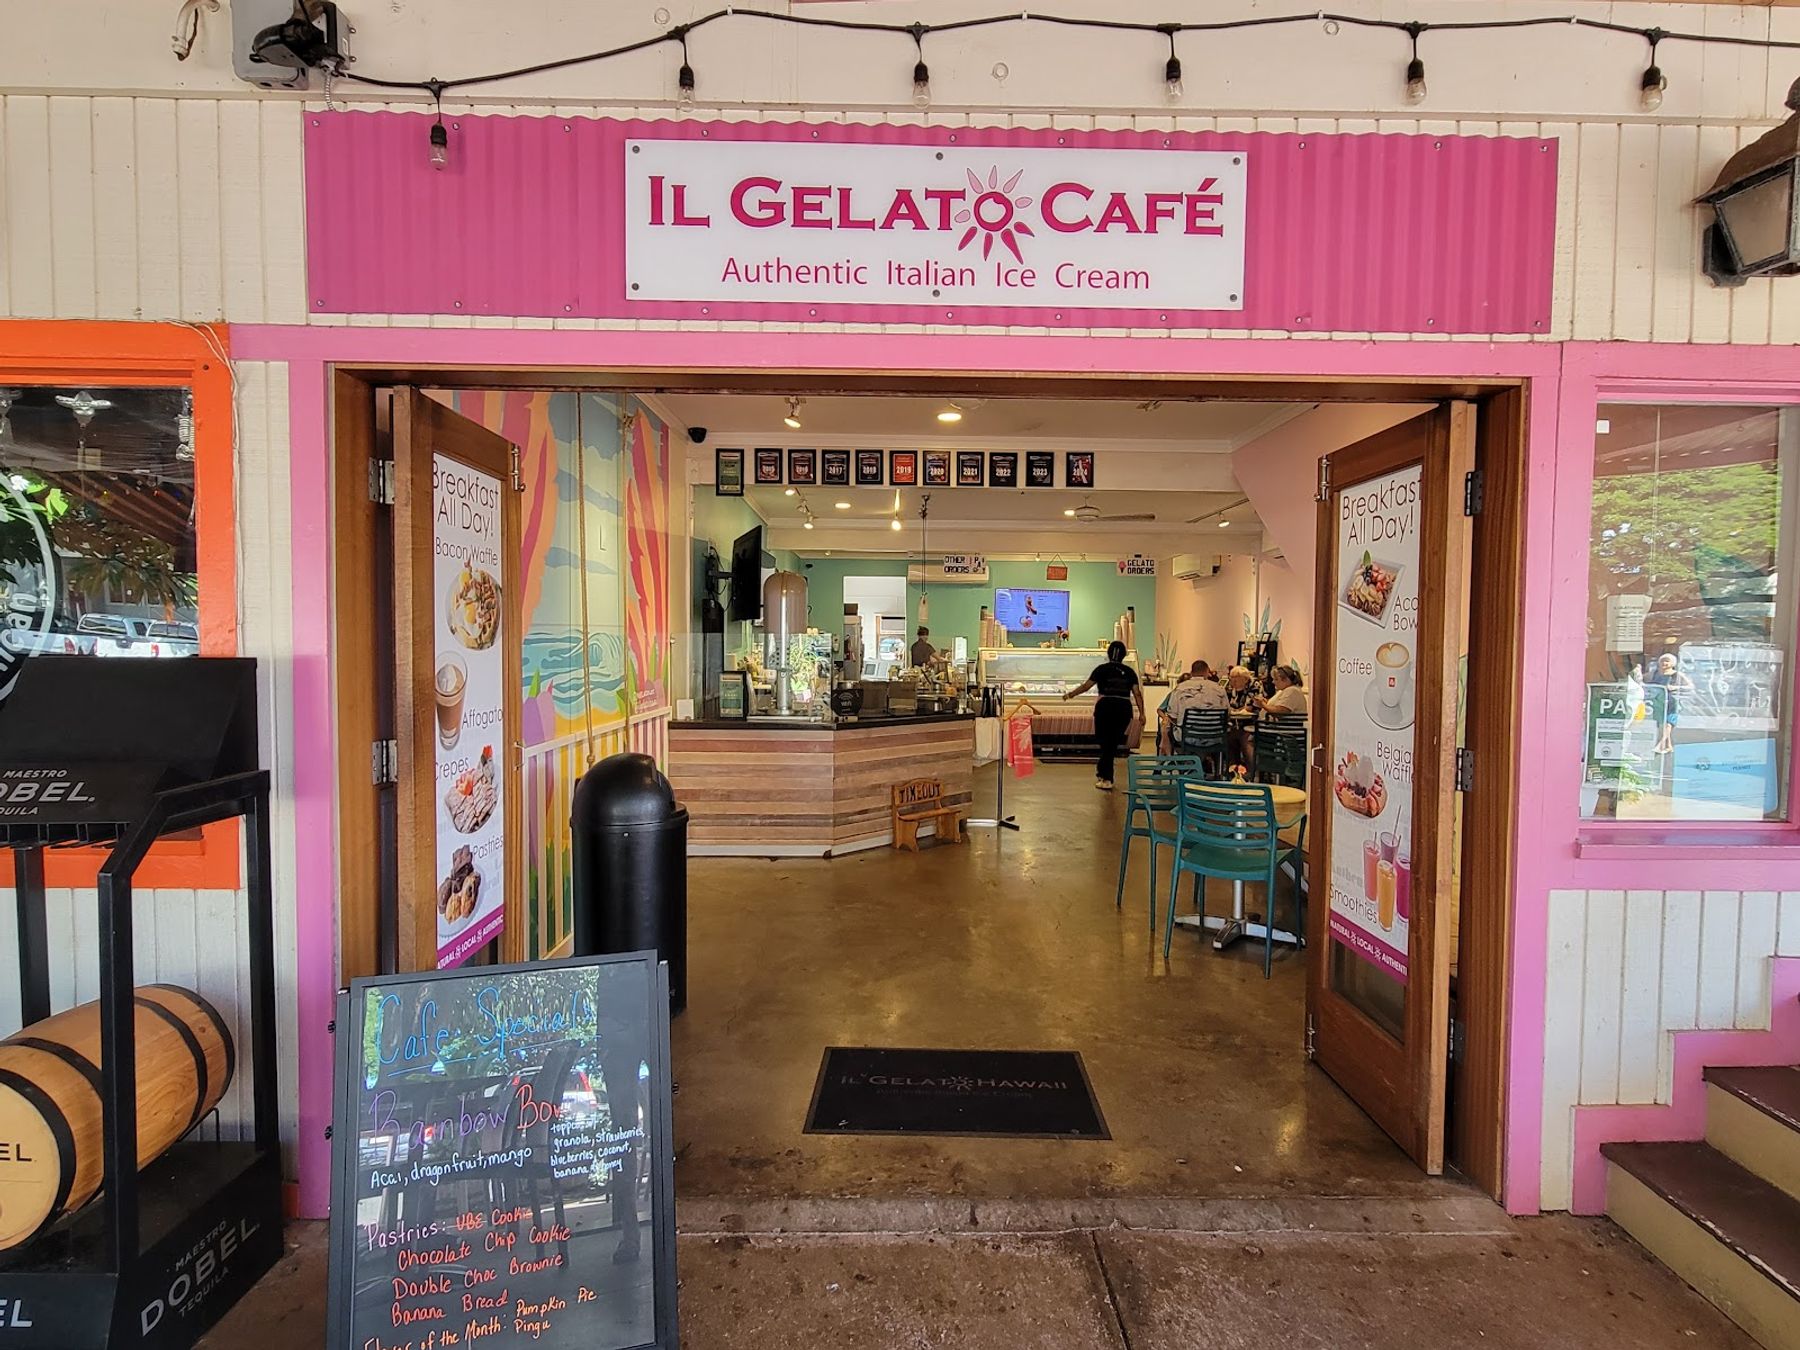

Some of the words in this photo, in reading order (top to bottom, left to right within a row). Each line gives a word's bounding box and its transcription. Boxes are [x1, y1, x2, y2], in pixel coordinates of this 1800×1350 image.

[648, 175, 711, 228] IL
[729, 176, 1015, 232] GELATO
[1041, 177, 1225, 238] CAFÉ
[721, 256, 868, 286] Authentic
[886, 259, 976, 287] Italian
[996, 262, 1037, 288] Ice
[1055, 262, 1151, 290] Cream
[896, 465, 912, 475] 2019
[963, 467, 978, 476] 2021
[1032, 467, 1048, 476] 2023
[433, 461, 499, 511] Breakfast
[437, 496, 456, 527] All
[461, 502, 494, 542] Day!
[1347, 520, 1366, 547] All
[1371, 506, 1414, 544] Day!
[435, 536, 469, 561] Bacon
[470, 543, 499, 566] Waffle
[1127, 559, 1155, 567] GELATO
[1127, 567, 1155, 575] ORDERS
[1338, 657, 1373, 676] Coffee
[462, 707, 503, 730] Affogato
[1600, 698, 1654, 717] PAS
[2, 769, 68, 779] MAESTRO
[435, 757, 470, 781] repes
[1329, 883, 1378, 924] Smoothies
[461, 934, 477, 953] LOCAL
[1356, 937, 1374, 955] LOCAL
[176, 1220, 227, 1273] MAESTRO
[366, 1220, 447, 1252] Pastries:
[398, 1241, 472, 1271] Chocolate
[484, 1231, 517, 1253] Chip
[528, 1222, 572, 1244] Cookie
[392, 1273, 453, 1301] Double
[463, 1267, 498, 1289] Choc
[508, 1253, 563, 1276] Brownie
[391, 1301, 447, 1328] Banana
[462, 1288, 509, 1313] Bread
[515, 1296, 566, 1318] Pumpkin
[577, 1286, 598, 1304] Pie
[420, 1330, 436, 1350] of
[439, 1329, 460, 1348] the
